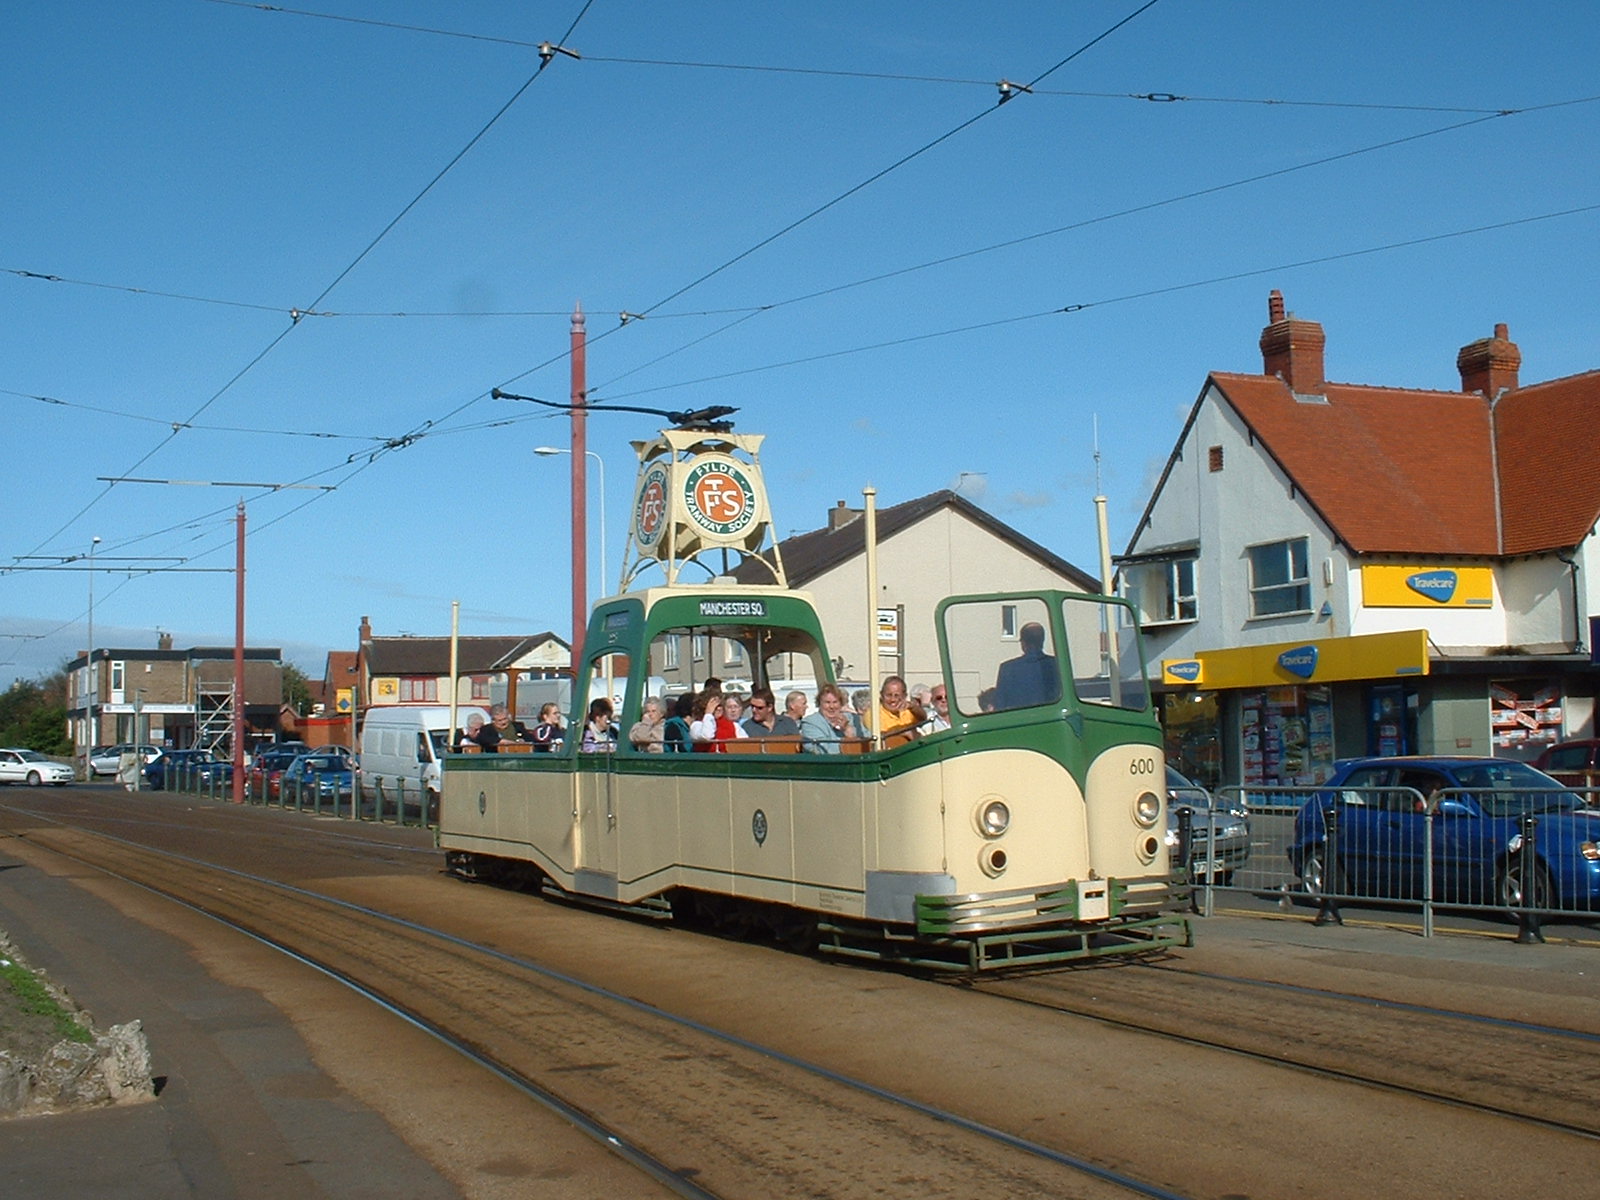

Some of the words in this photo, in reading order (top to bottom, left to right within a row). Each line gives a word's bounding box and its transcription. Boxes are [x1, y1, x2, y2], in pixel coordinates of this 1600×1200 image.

[695, 463, 737, 477] FYLDE
[685, 490, 723, 533] TRAMWAY
[727, 489, 755, 533] SOCIETY
[1413, 577, 1455, 589] Travelcare
[700, 602, 751, 616] MANCHESTER
[1129, 757, 1155, 775] 600
